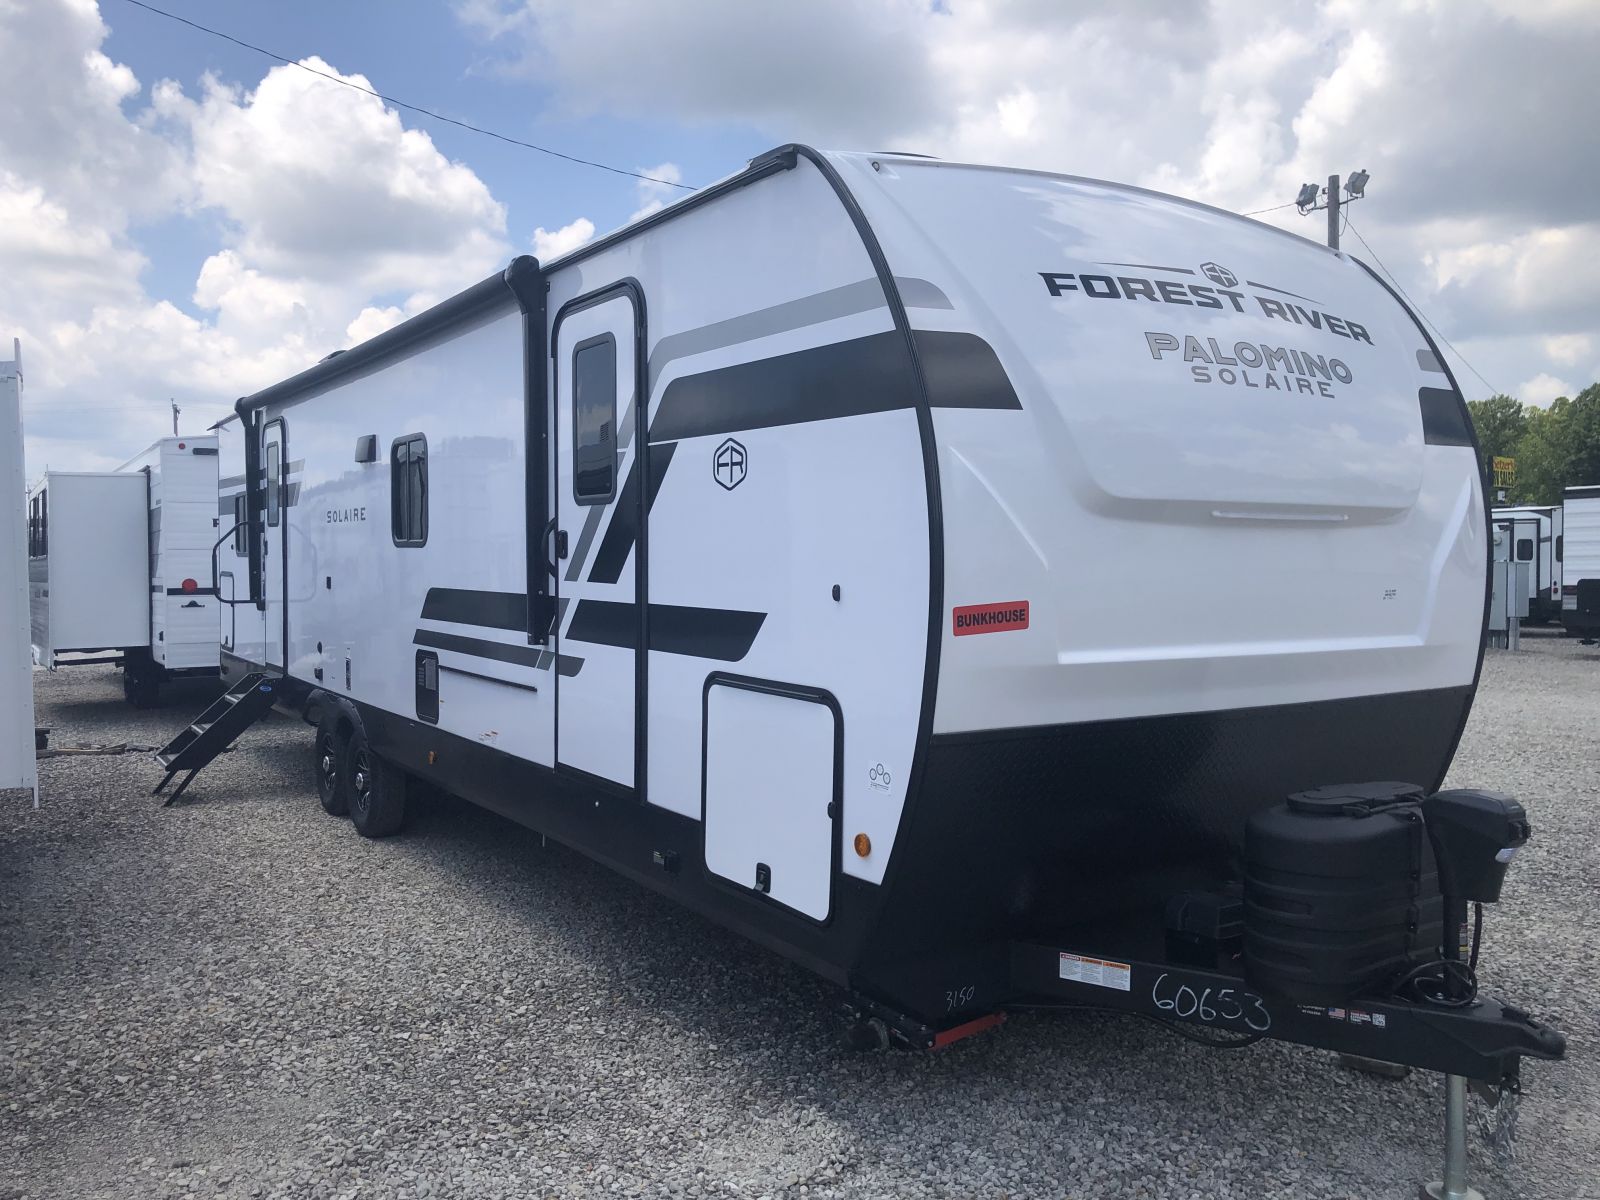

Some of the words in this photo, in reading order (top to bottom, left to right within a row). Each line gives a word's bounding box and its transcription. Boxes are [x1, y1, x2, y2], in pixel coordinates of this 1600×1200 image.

[1037, 272, 1245, 313] FOREST
[1256, 296, 1375, 346] RIVER
[1144, 332, 1353, 384] PALOMINO
[1191, 366, 1335, 399] SOLAIRE
[326, 507, 366, 524] SOLAIRE
[956, 608, 1026, 628] BUNKHOUSE
[945, 984, 975, 1012] 3150
[1152, 973, 1271, 1031] 60653
